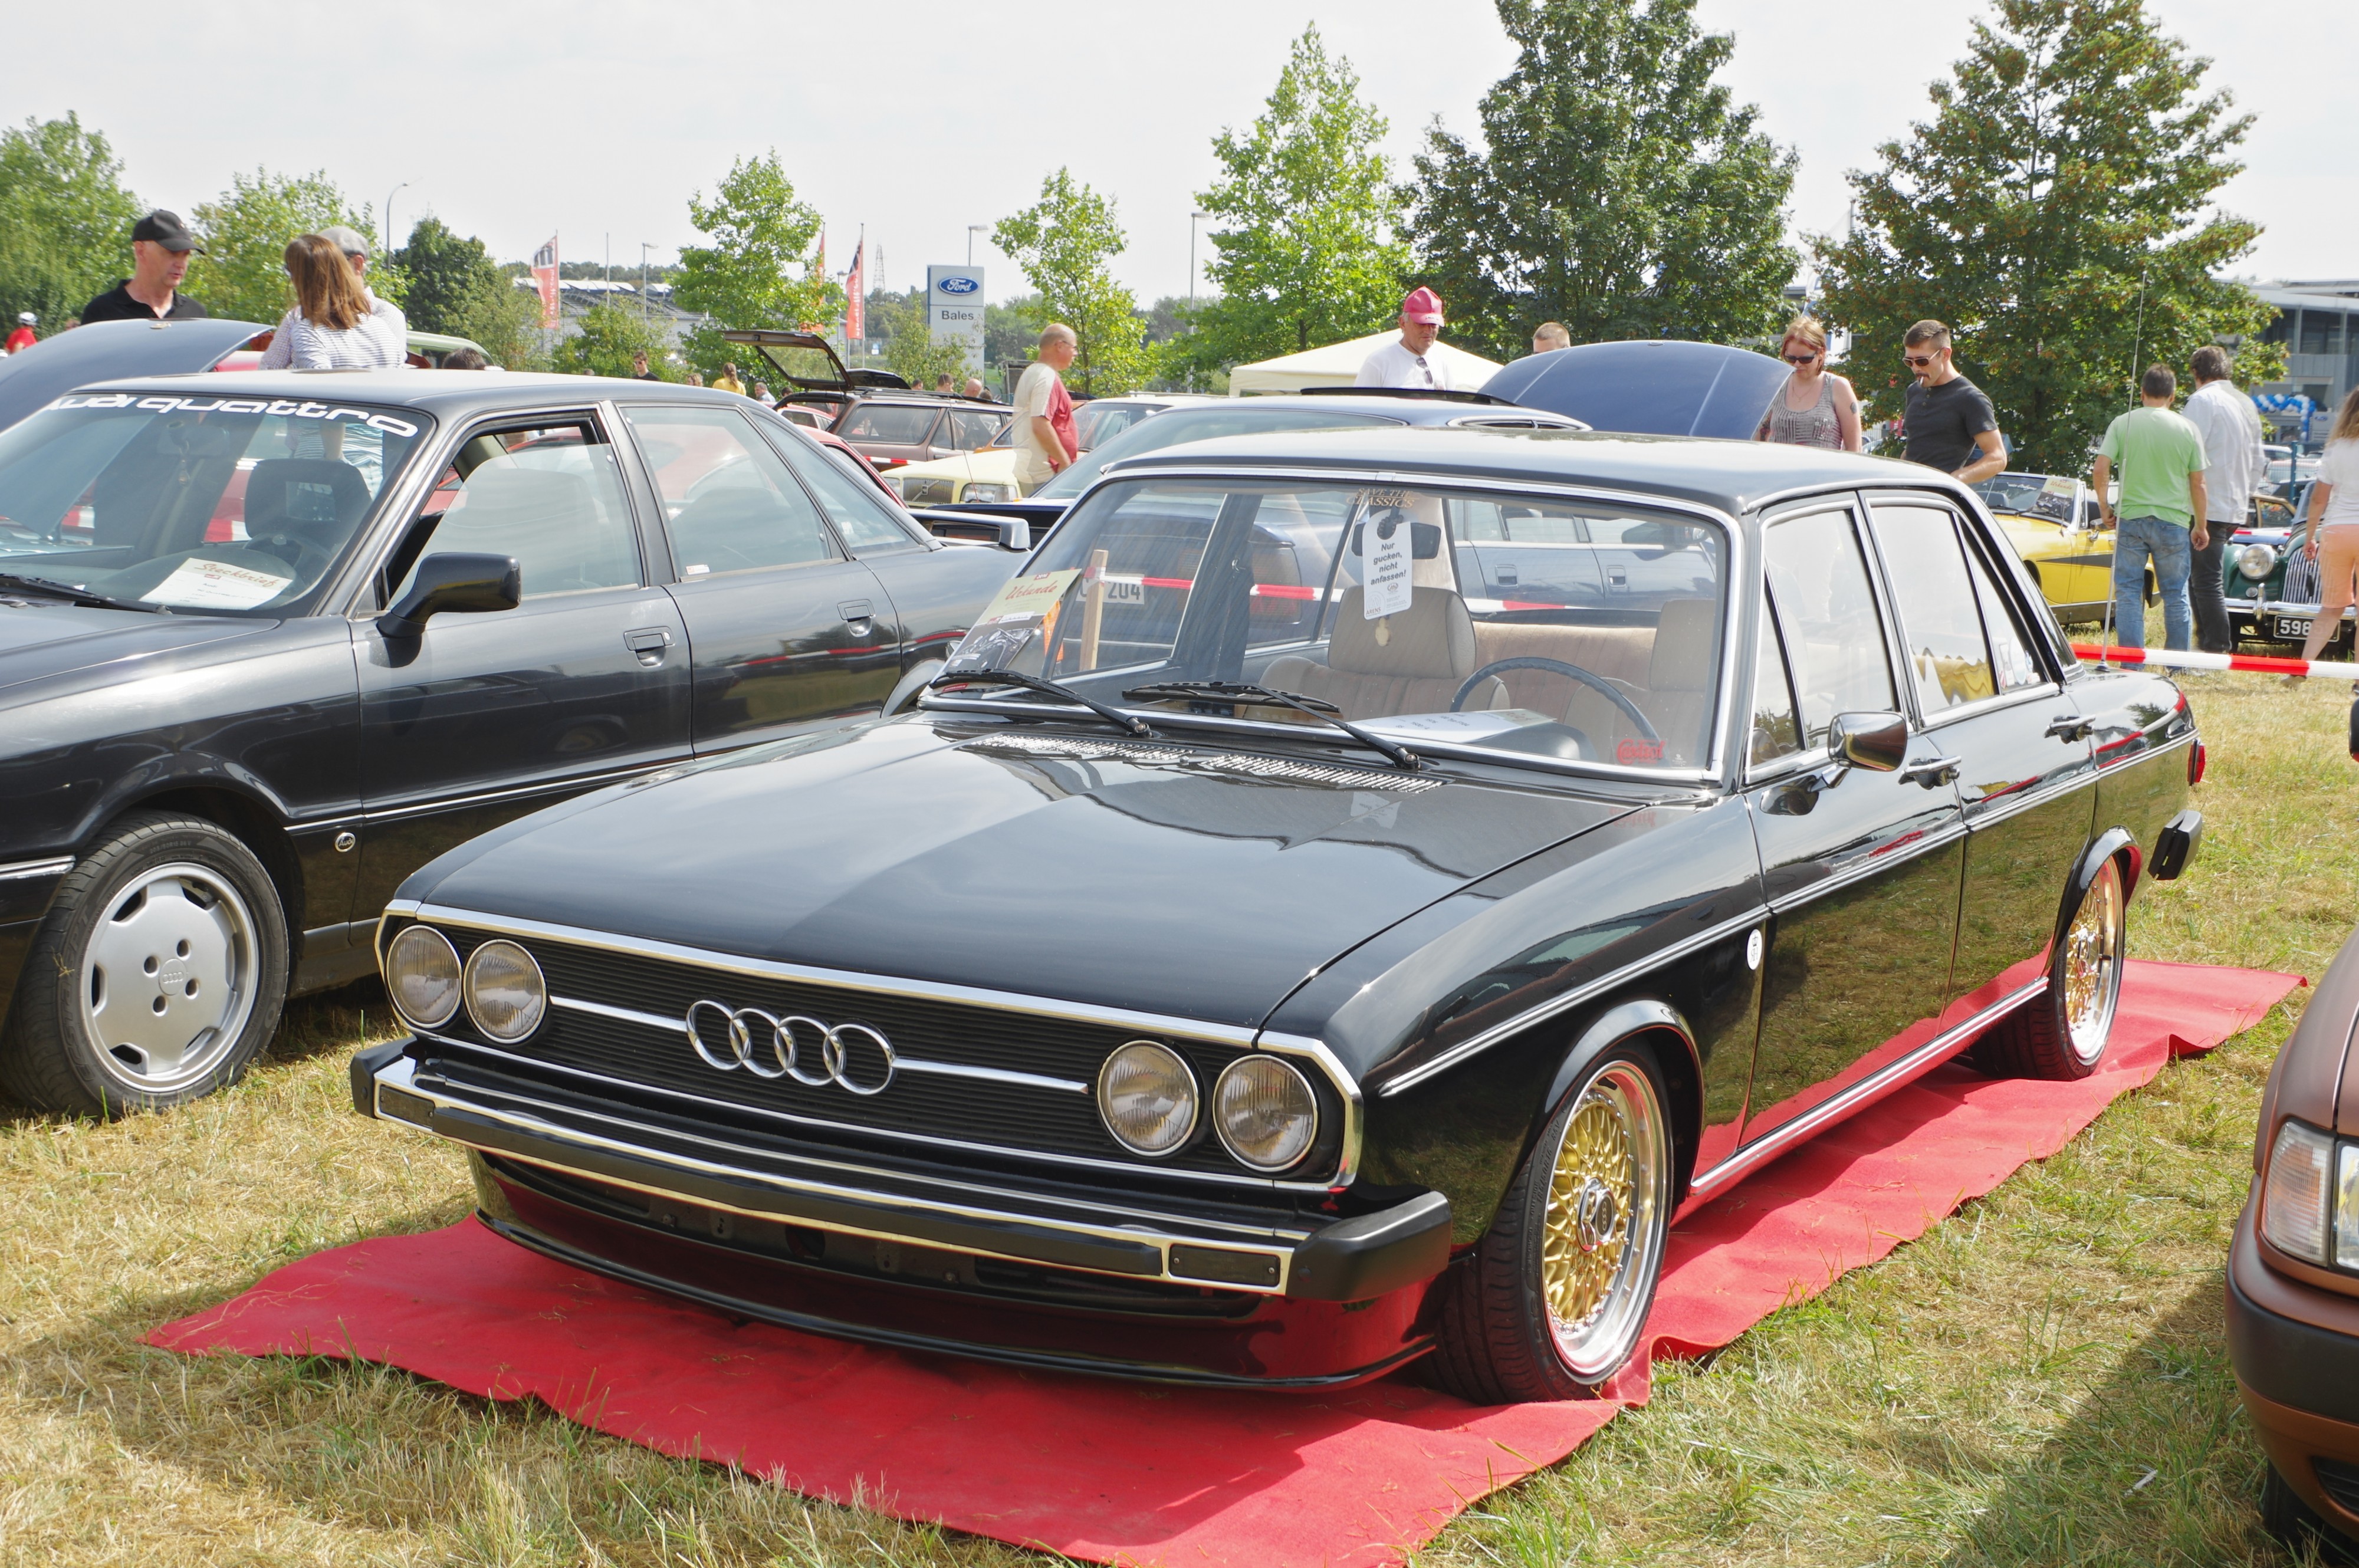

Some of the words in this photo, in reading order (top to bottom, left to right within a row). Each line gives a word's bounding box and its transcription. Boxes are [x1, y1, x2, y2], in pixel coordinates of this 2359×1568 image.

[947, 279, 972, 291] Ford
[941, 310, 974, 320] Bales
[136, 397, 419, 438] quattro
[1356, 488, 1387, 496] SAVE
[1389, 489, 1413, 497] THE
[1346, 495, 1415, 508] CLASSICS
[1381, 543, 1395, 551] Nur
[1373, 551, 1402, 566] gucken,
[1379, 561, 1398, 573] nicht
[194, 563, 280, 587] Steckbrief
[1371, 569, 1407, 586] anfassen!
[1005, 580, 1058, 600] Urkunde
[1366, 607, 1381, 615] ARENS
[1617, 738, 1666, 765] Castrol
